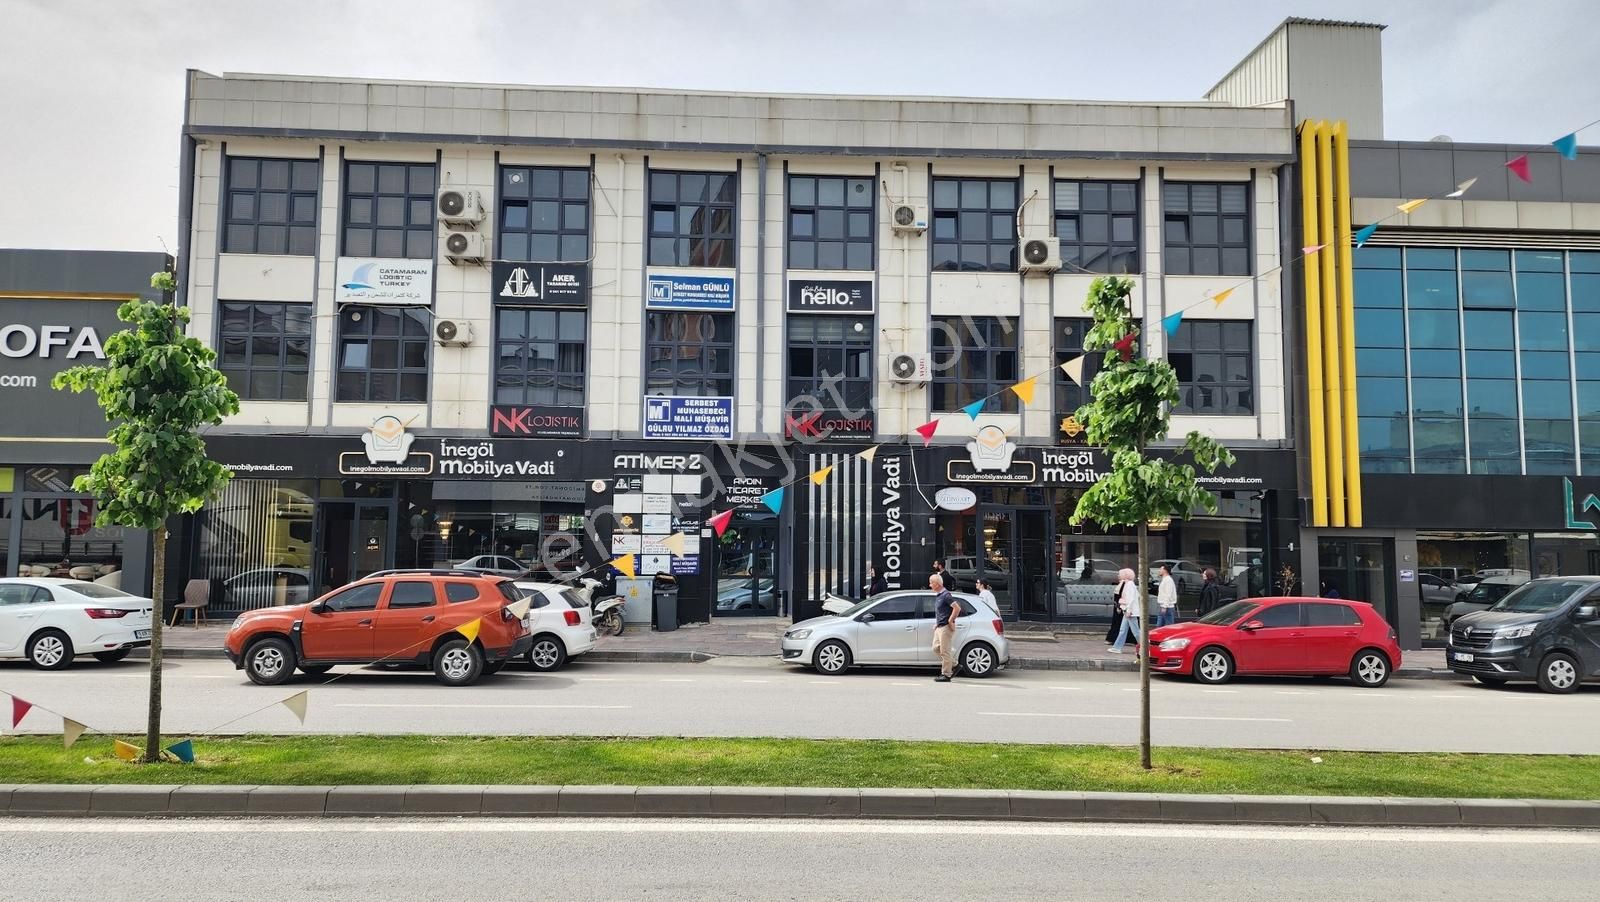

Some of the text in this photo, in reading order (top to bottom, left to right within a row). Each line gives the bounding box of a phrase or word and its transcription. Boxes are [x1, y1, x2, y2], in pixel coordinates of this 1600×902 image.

[552, 274, 576, 282] AKER
[673, 281, 730, 292] Selman GÜNLÜ
[0, 323, 106, 360] OFA
[684, 399, 719, 407] SERBEST
[493, 407, 533, 434] NK
[673, 414, 729, 425] MALİ MÜŞAVİR
[785, 410, 824, 438] NK
[647, 423, 730, 433] GÜLRU YILMAZ ÖZDAĞ
[733, 477, 762, 486] AYDIN
